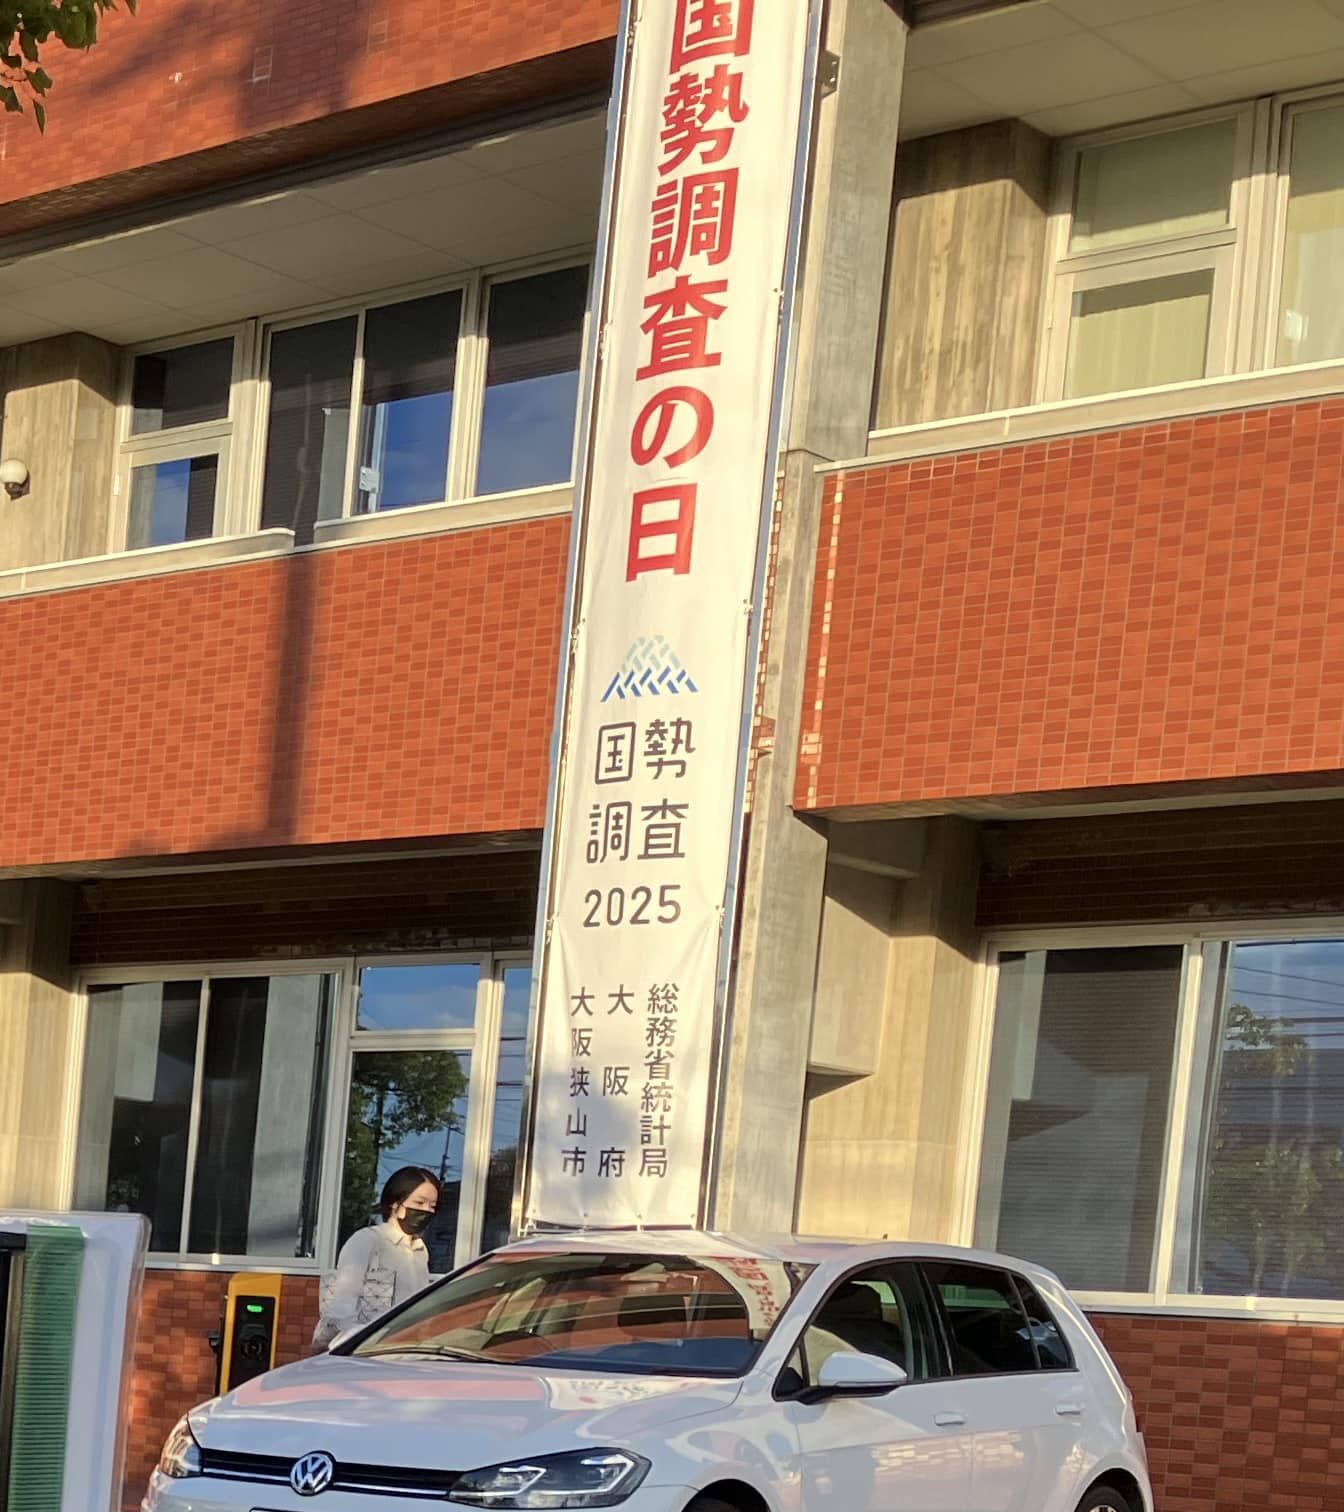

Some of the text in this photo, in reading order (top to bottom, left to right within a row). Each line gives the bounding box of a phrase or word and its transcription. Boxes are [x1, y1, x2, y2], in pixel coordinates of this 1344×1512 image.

[625, 0, 755, 583] 国勢調査の日
[585, 798, 690, 864] 調査
[595, 717, 698, 785] 国勢
[582, 884, 682, 928] 2025
[560, 986, 596, 1179] 大阪狭山市
[597, 983, 636, 1179] 大阪府
[638, 982, 680, 1180] 総務省統計局
